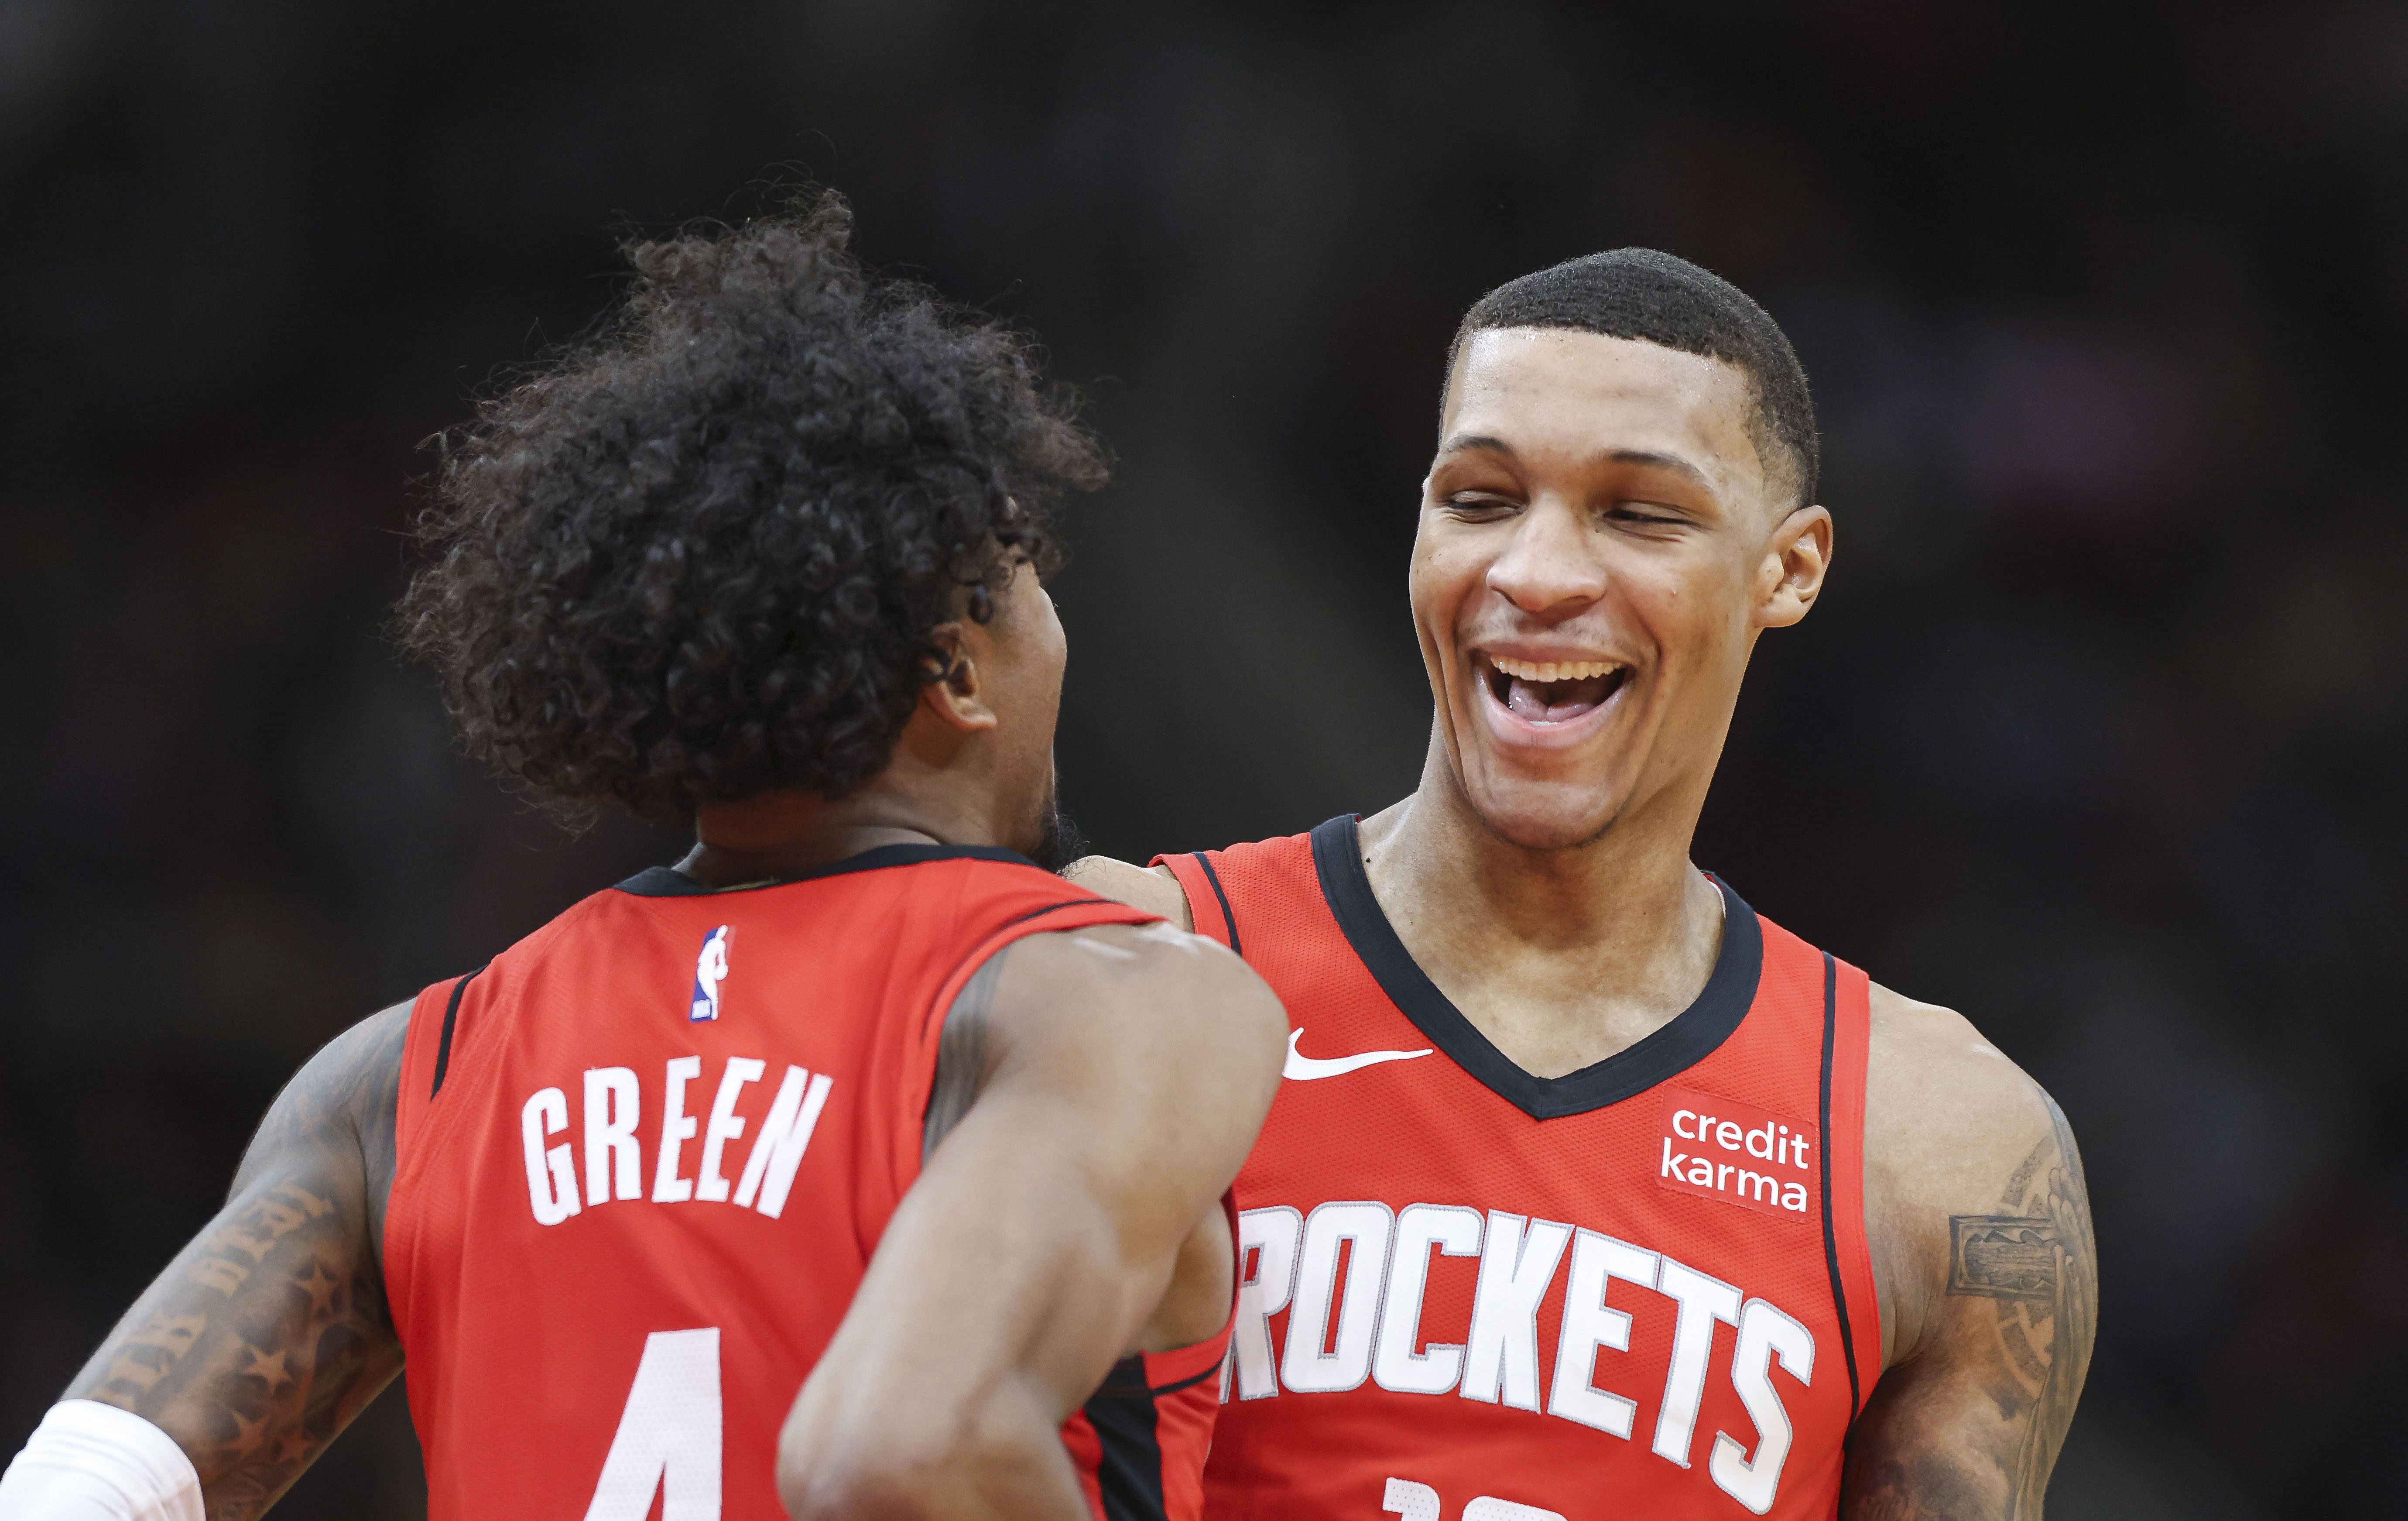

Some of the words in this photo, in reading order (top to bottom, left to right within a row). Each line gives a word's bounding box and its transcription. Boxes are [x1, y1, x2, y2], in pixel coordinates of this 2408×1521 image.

[521, 1054, 834, 1226] GREEN
[1661, 1136, 1808, 1213] karma
[1672, 1109, 1810, 1170] credit
[1219, 1200, 1816, 1515] ROCKETS
